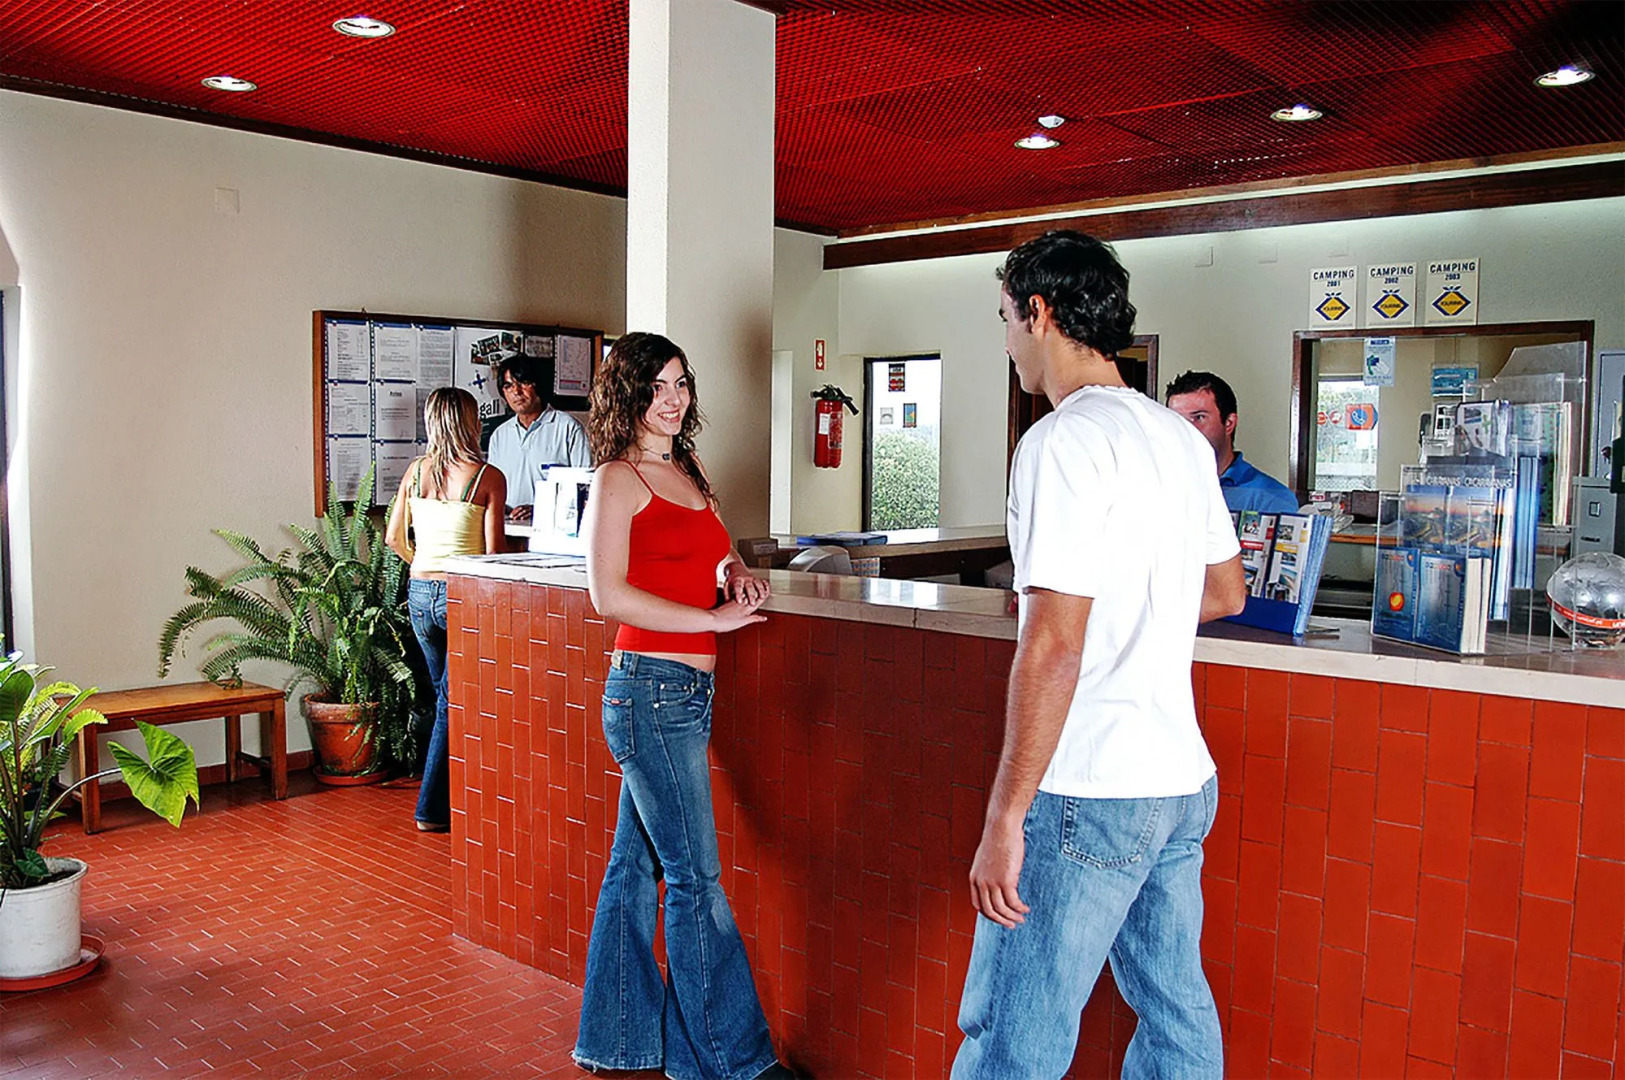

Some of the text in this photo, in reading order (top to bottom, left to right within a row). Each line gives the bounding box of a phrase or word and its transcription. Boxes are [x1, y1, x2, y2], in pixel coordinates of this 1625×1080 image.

[1370, 265, 1414, 277] CAMPING
[1430, 262, 1476, 274] CAMPING
[1313, 269, 1355, 280] CAMPING
[1445, 273, 1460, 281] 2003
